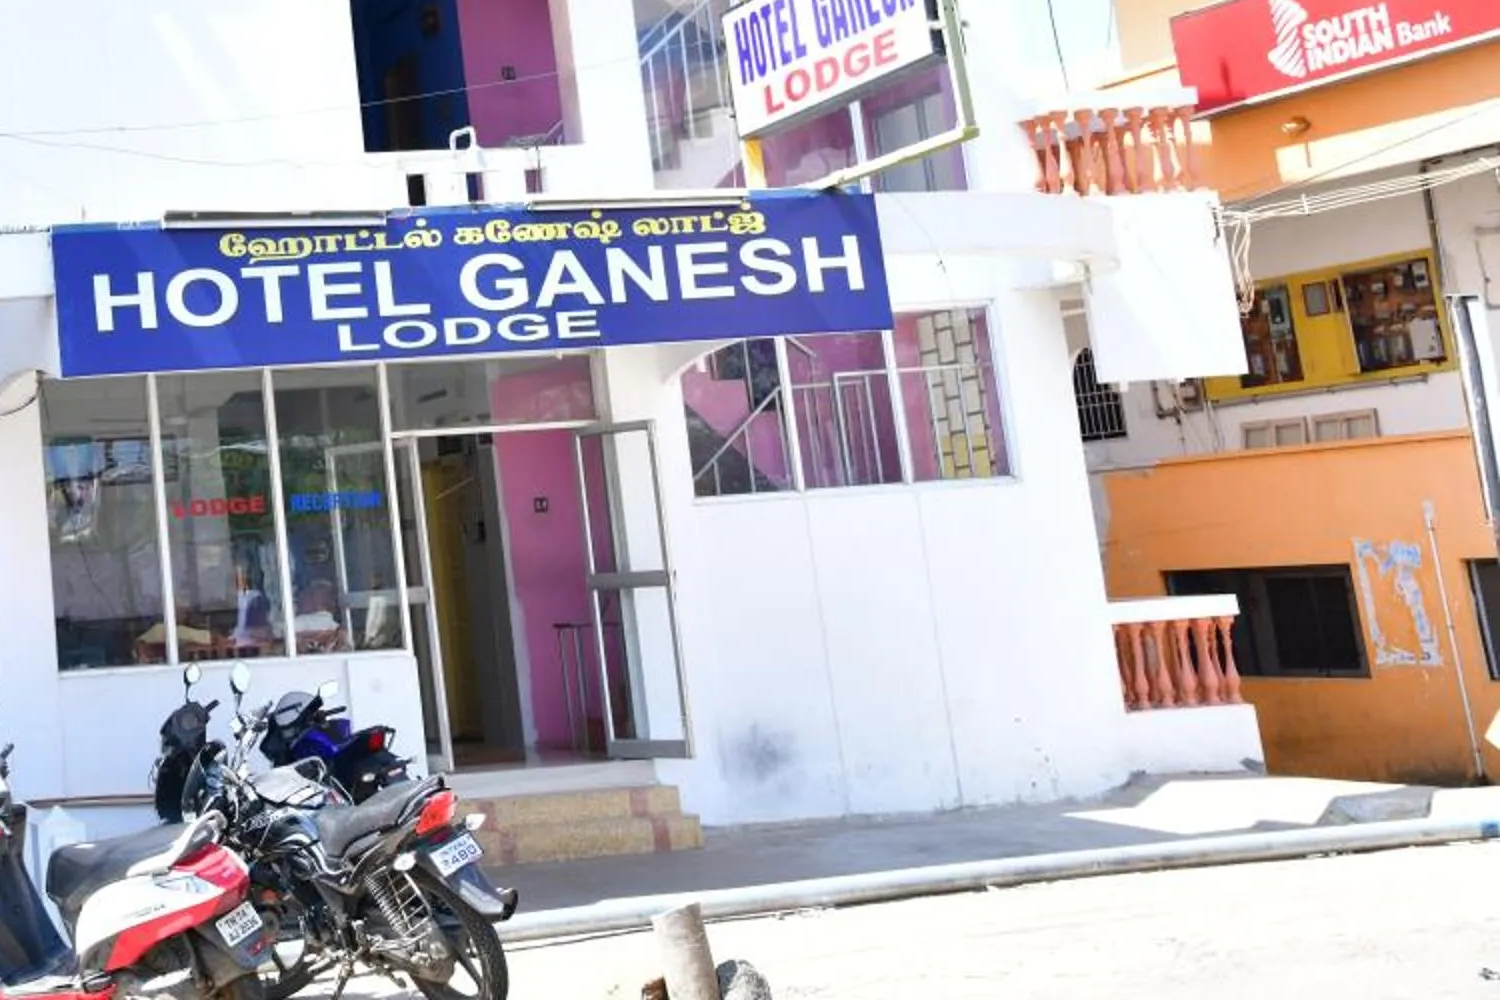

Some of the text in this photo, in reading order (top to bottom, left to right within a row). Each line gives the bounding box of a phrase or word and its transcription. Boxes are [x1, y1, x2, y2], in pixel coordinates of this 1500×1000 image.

[1302, 2, 1390, 49] SOUTH
[1305, 11, 1452, 71] INDIAN Bank
[763, 28, 899, 115] LODGE
[219, 202, 767, 265] ஹோட்டல் கணேஷ் லாட்ஜ்
[91, 233, 867, 334] HOTEL GANESH
[337, 309, 602, 354] LODGE
